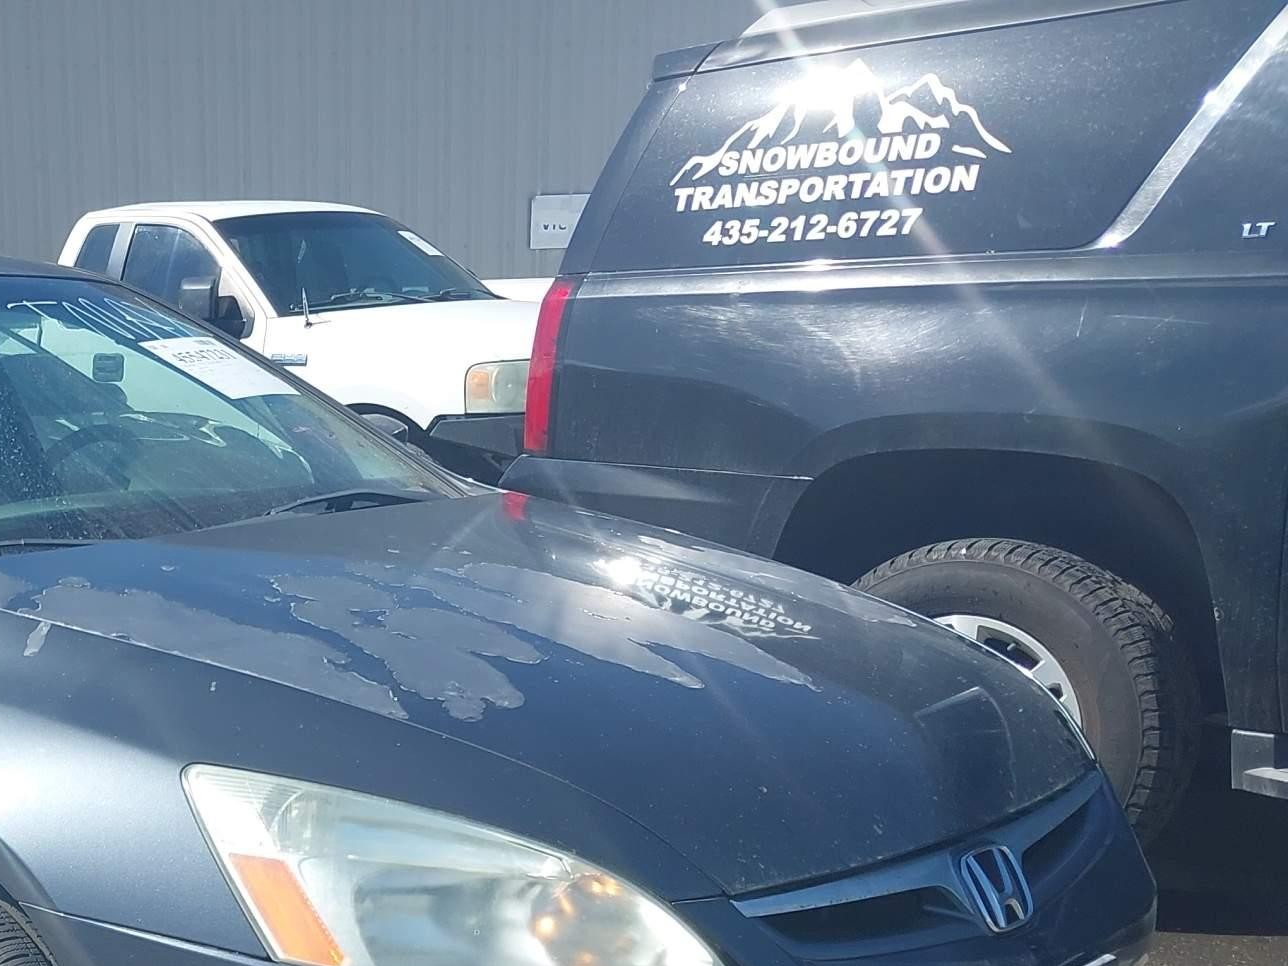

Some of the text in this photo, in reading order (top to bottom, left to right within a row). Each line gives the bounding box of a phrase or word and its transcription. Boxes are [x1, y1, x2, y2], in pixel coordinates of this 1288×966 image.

[717, 132, 941, 177] SNOWBOUND
[674, 164, 980, 212] TRANSPORTATION
[702, 207, 924, 246] 435-212-6727
[1242, 221, 1276, 238] LT
